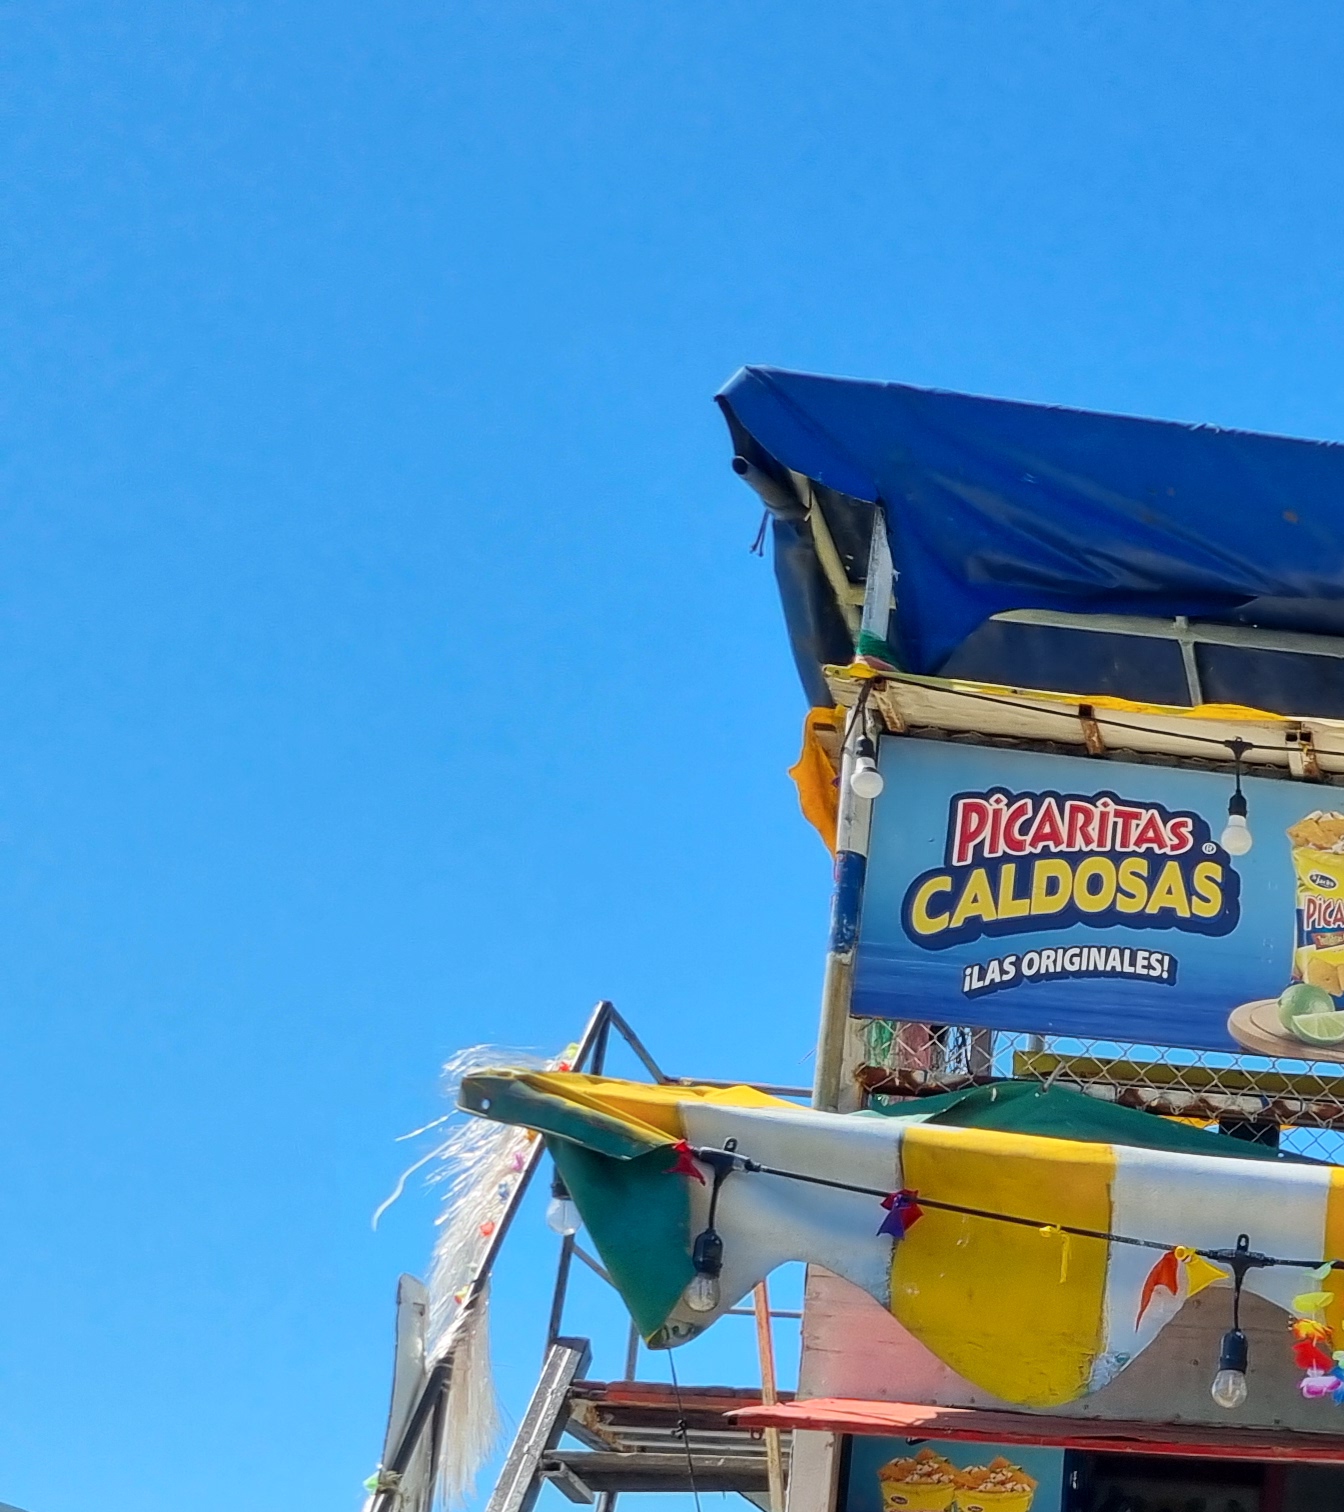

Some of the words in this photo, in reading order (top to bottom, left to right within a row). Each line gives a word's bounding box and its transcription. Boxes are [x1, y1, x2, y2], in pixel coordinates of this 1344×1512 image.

[910, 856, 1223, 936] CALDOSAS
[963, 955, 1017, 993] ¡LAS
[1021, 948, 1170, 979] ORIGINALES!
